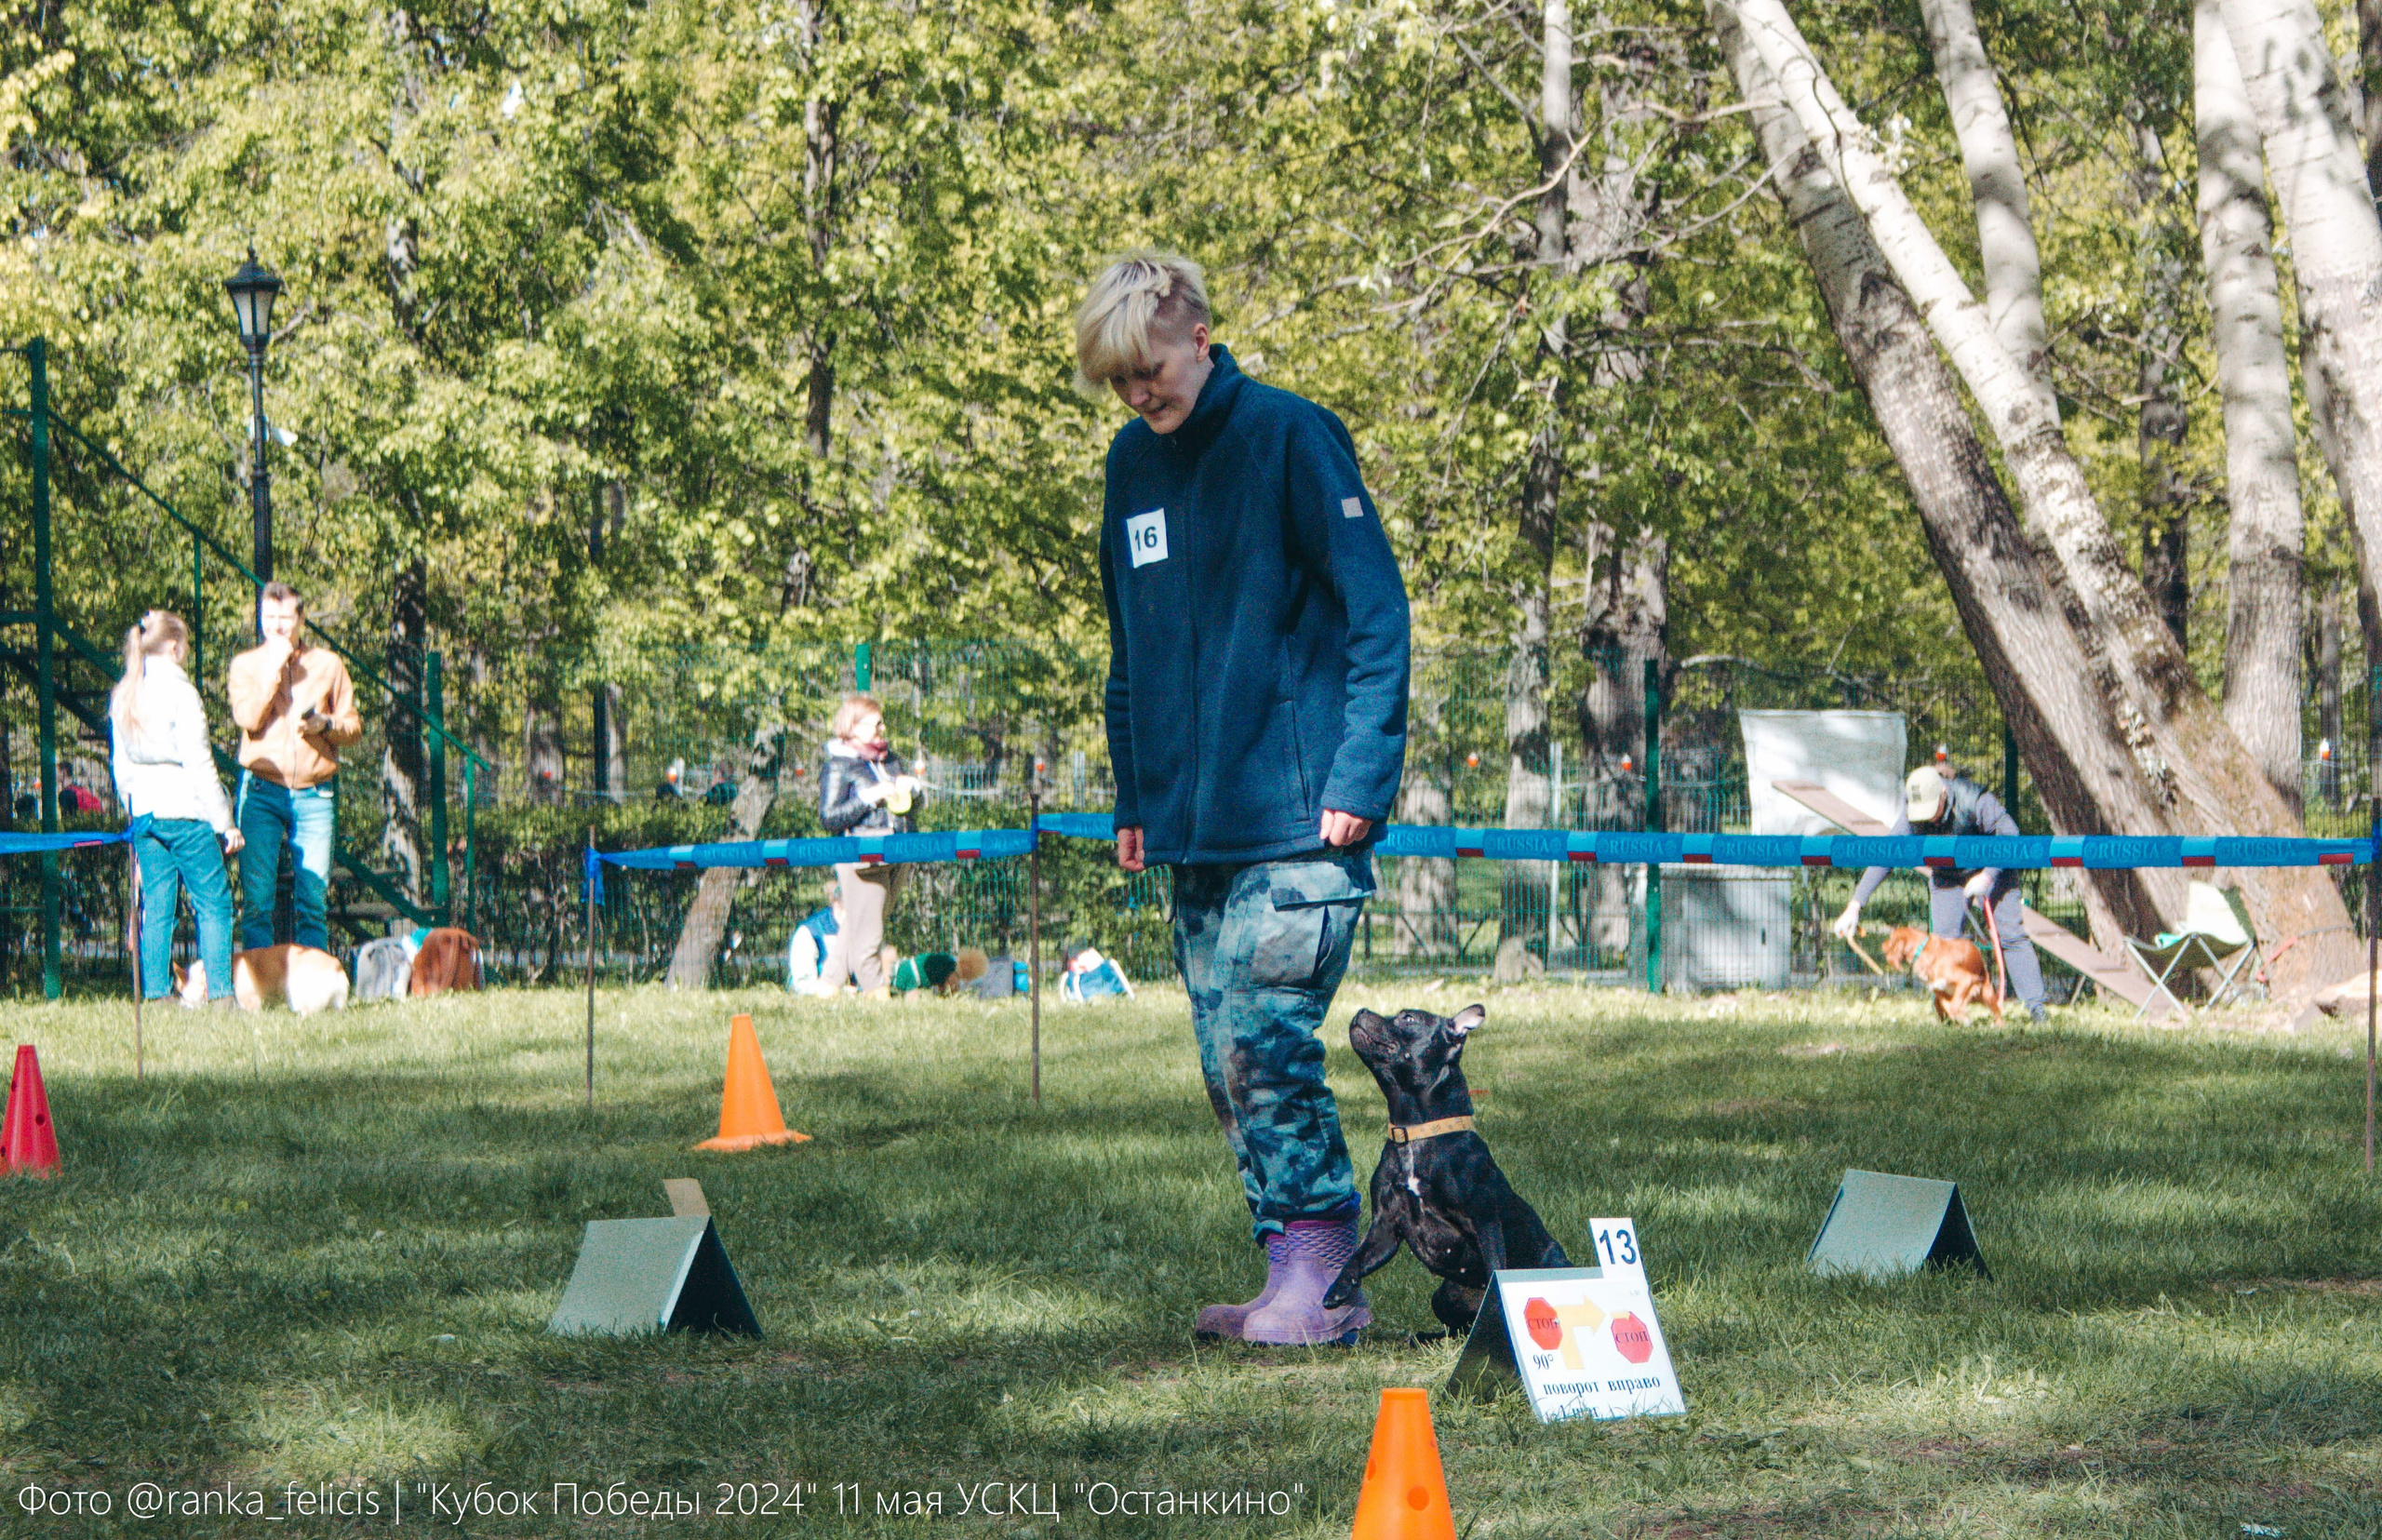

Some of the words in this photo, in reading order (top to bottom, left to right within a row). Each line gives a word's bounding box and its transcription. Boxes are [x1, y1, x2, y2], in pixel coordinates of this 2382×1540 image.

[1134, 526, 1158, 552] 16
[798, 843, 845, 859] RUSSIA
[894, 839, 942, 855] RUSSIA
[1386, 832, 1439, 849] RUSSIA
[1496, 834, 1550, 851] RUSSIA
[1609, 838, 1665, 854] RUSSIA
[1725, 841, 1783, 856] RUSSIA
[1845, 842, 1904, 859] RUSSIA
[1969, 842, 2029, 859] RUSSIA
[2098, 841, 2161, 859] RUSSIA
[2230, 841, 2295, 858] RUSSIA
[1599, 1228, 1637, 1265] 13
[1527, 1317, 1559, 1331] СТОП
[1614, 1330, 1649, 1344] СТОП
[1532, 1353, 1554, 1370] 90°
[1543, 1381, 1599, 1398] поворот
[1608, 1375, 1661, 1394] вправо
